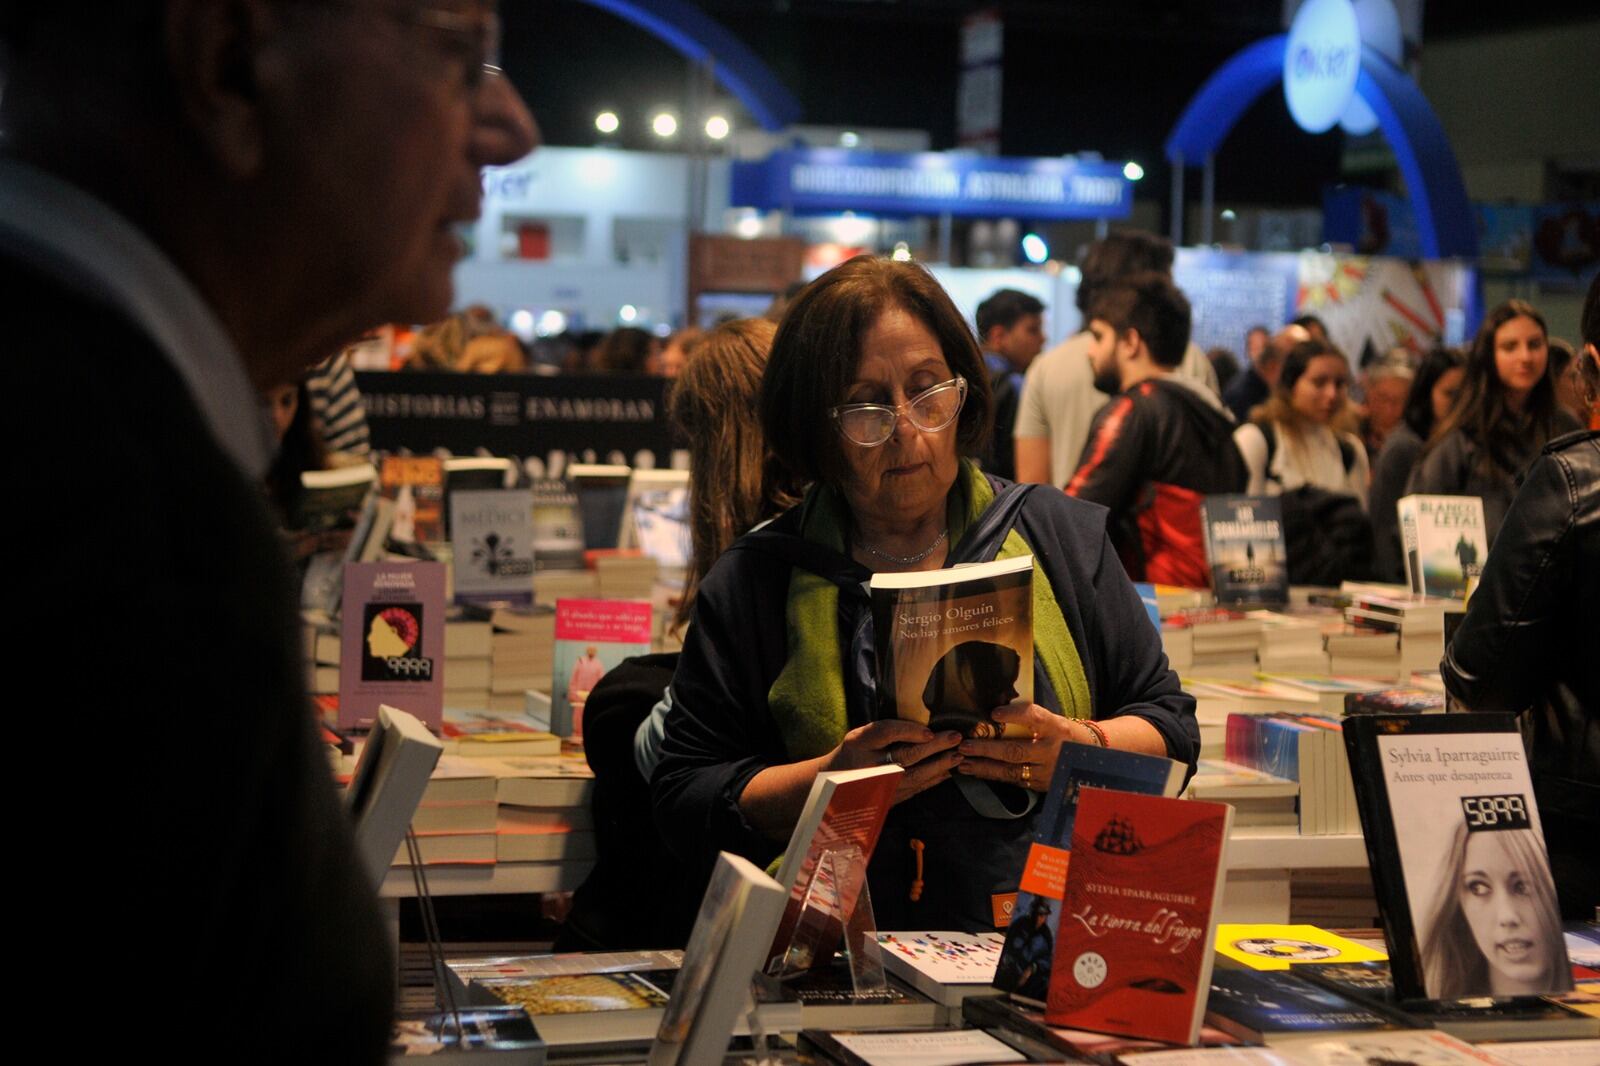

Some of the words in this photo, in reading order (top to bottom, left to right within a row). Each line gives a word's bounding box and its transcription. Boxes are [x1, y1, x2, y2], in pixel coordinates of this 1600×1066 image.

[525, 396, 655, 422] ENAMORAN
[1420, 501, 1478, 514] BLANCO
[1434, 513, 1479, 526] LETAL
[898, 613, 942, 627] Sergio
[945, 604, 994, 621] Olguín
[900, 630, 918, 640] No
[920, 628, 940, 639] hay
[942, 623, 980, 635] amores
[982, 615, 1014, 628] felices
[1388, 748, 1433, 765] Sylvia
[1436, 747, 1521, 765] Iparraguirre
[1393, 770, 1425, 783] Antes
[1427, 772, 1448, 785] que
[1450, 770, 1513, 784] desaparezca
[1464, 796, 1528, 825] 5899
[1085, 884, 1120, 896] SYLVIA
[1122, 888, 1197, 905] IPARRAGUIRRE
[1072, 905, 1108, 937] La
[1100, 914, 1141, 931] tierra
